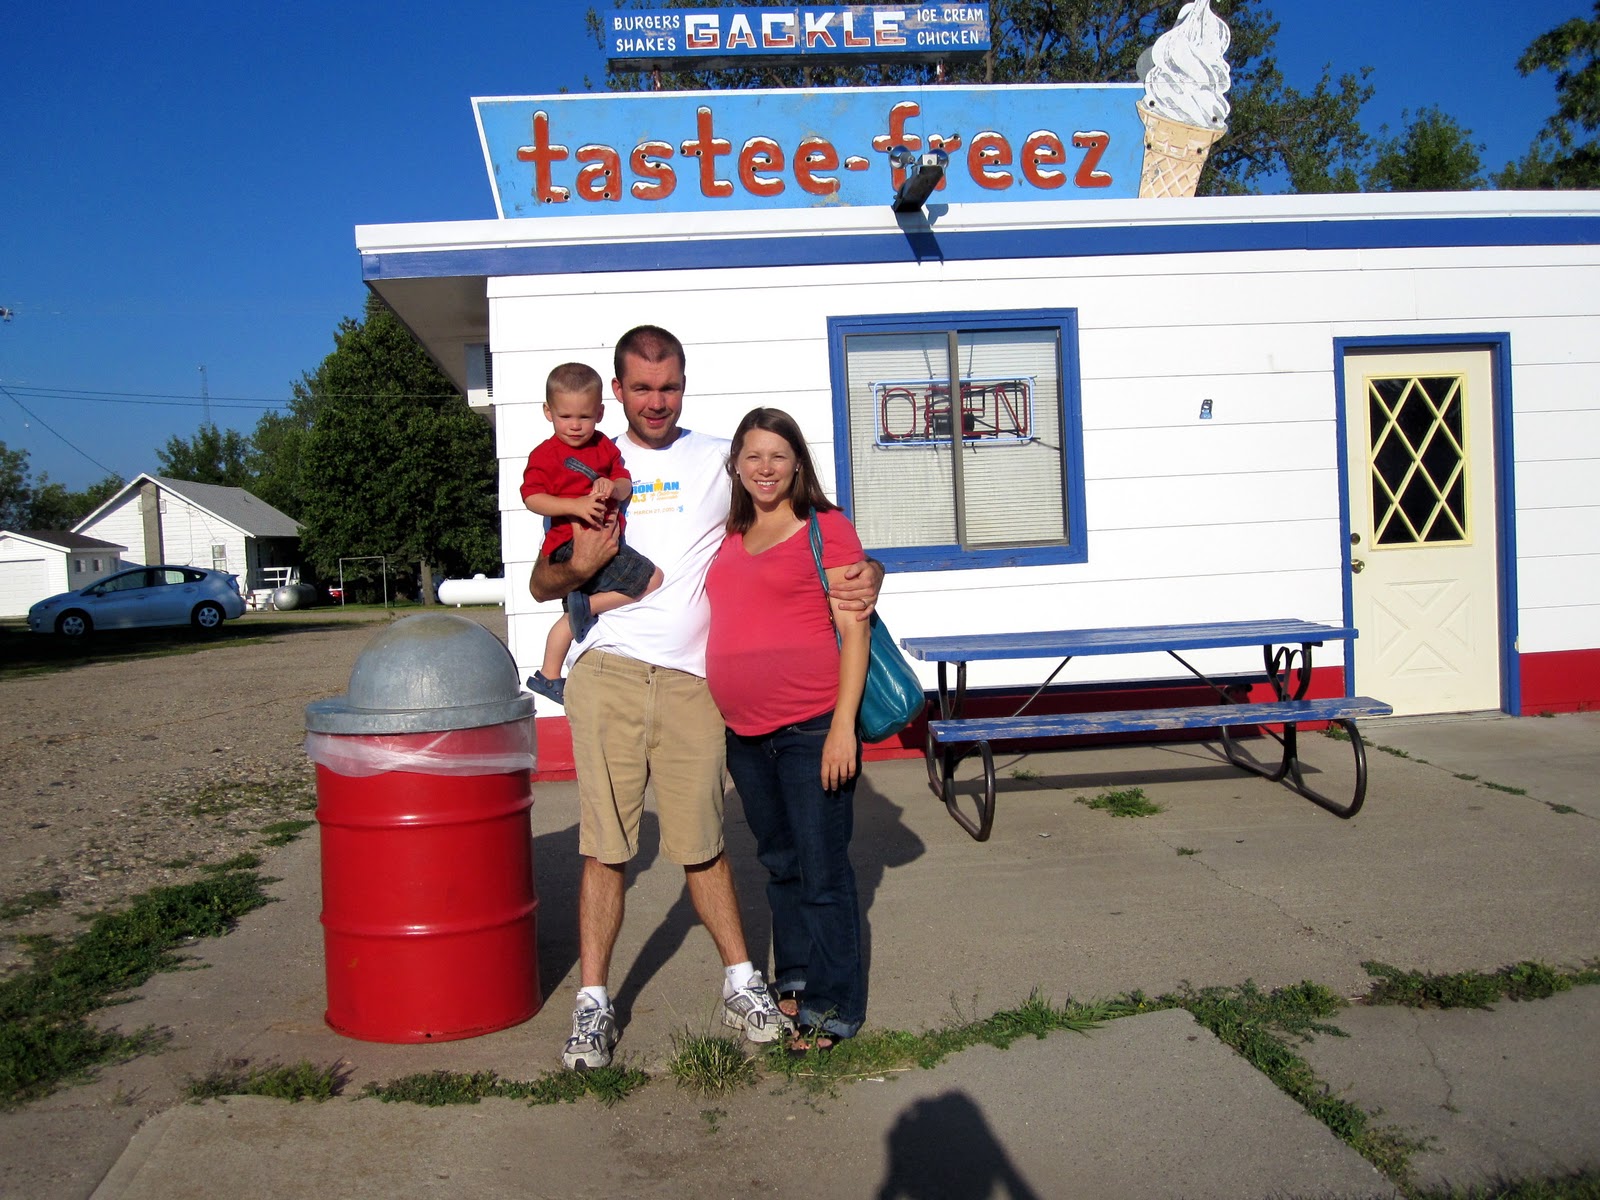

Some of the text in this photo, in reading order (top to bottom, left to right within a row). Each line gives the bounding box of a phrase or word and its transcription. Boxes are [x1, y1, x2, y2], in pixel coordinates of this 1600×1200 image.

[614, 15, 680, 30] BURGERS
[917, 8, 984, 22] ICE CREAM
[684, 11, 907, 50] GACKLE
[917, 30, 979, 46] CHICKEN
[616, 37, 676, 52] SHAKES
[881, 383, 1028, 440] OPEN
[632, 479, 680, 494] RONMAN
[631, 493, 647, 503] 0.3
